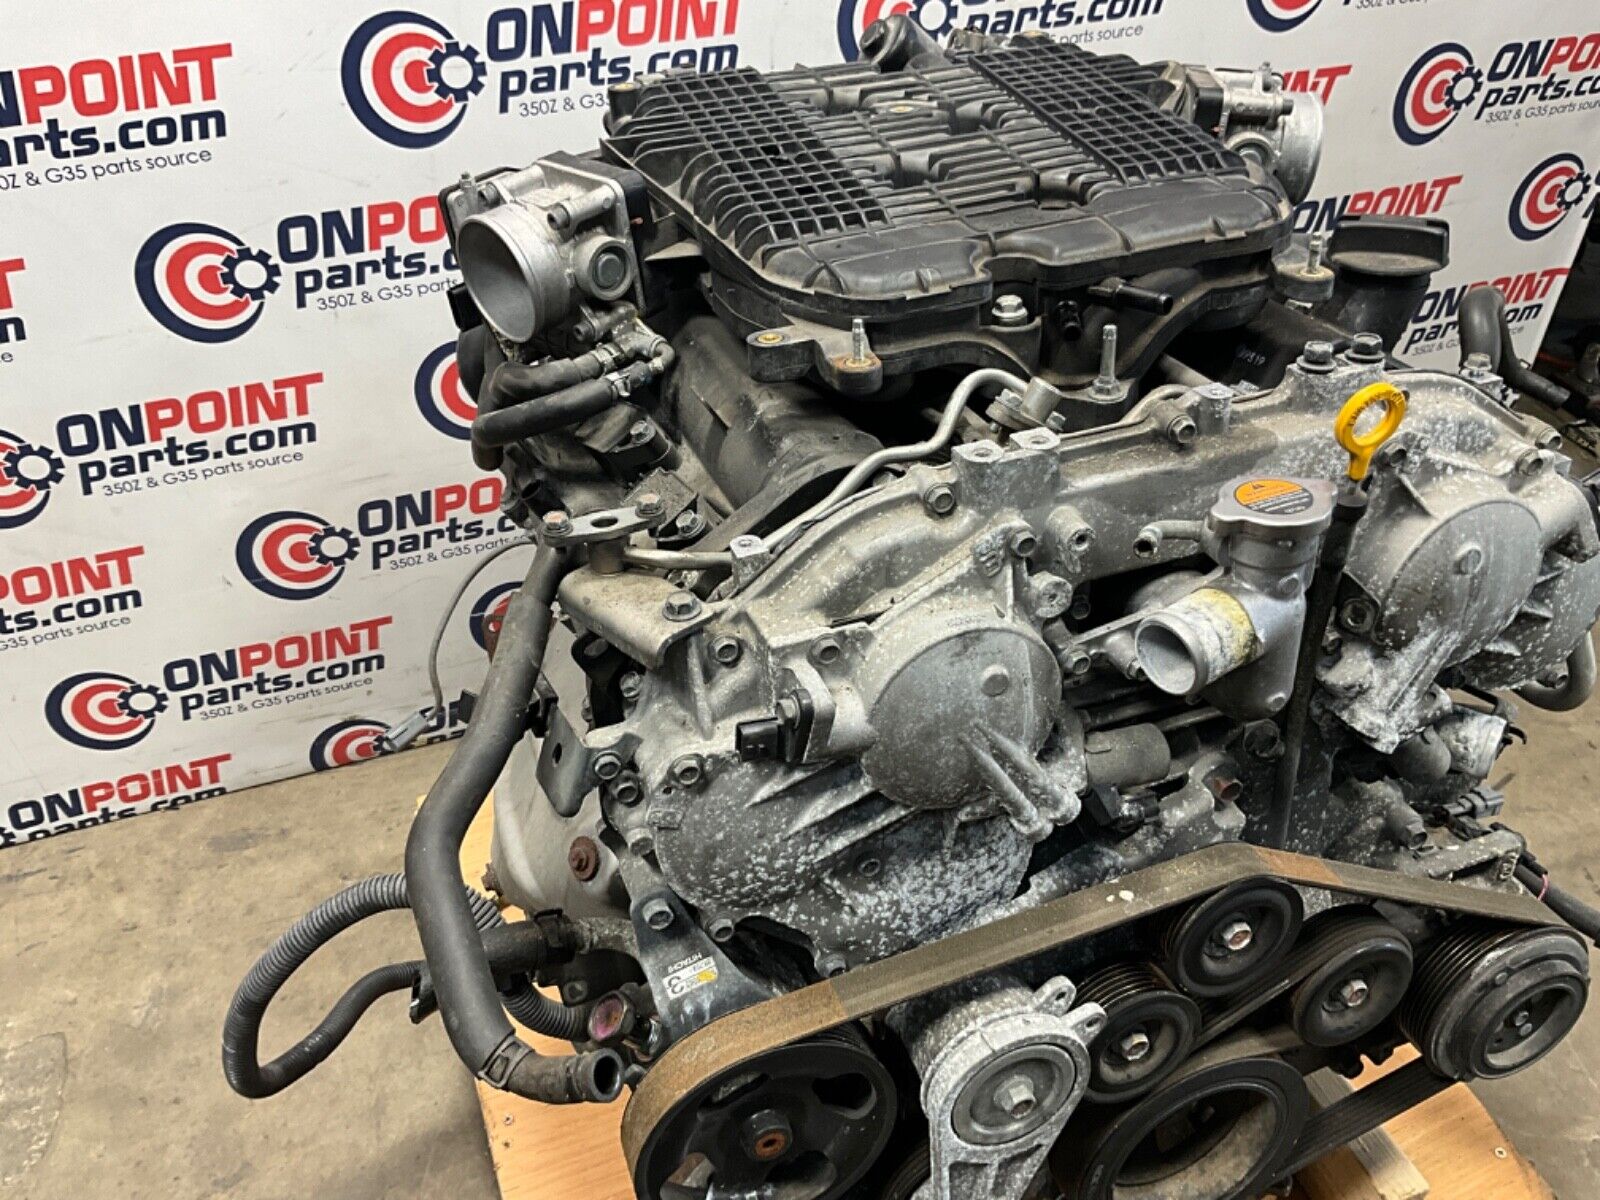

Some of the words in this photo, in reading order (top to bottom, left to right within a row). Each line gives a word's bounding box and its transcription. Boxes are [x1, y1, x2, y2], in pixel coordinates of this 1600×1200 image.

[1096, 24, 1144, 42] source
[519, 101, 557, 117] 350Z
[563, 97, 575, 112] &
[579, 94, 610, 108] G3
[1525, 104, 1547, 118] G35
[1549, 101, 1575, 117] parts
[25, 170, 41, 187] &
[45, 164, 87, 184] G35
[92, 159, 142, 181] parts
[146, 149, 212, 171] source
[1293, 174, 1463, 233] ONPOINT
[317, 293, 356, 310] 350Z
[361, 291, 373, 304] &
[378, 284, 413, 301] G35
[417, 278, 457, 297] parts
[56, 372, 324, 457] ONPOINT
[79, 422, 316, 496] parts.com
[103, 478, 141, 496] 350Z
[147, 476, 159, 488] &
[163, 469, 198, 485] G35
[202, 462, 244, 480] parts
[248, 451, 304, 470] source
[0, 546, 145, 605] OINT
[390, 555, 421, 571] 350Z
[427, 552, 438, 563] &
[441, 545, 471, 560] G35
[32, 627, 73, 645] parts
[77, 616, 131, 634] source
[163, 615, 393, 692] ONPOINT
[180, 654, 385, 721] parts.com
[200, 707, 233, 721] 350Z
[238, 705, 248, 714] &
[252, 695, 282, 710] G35
[285, 689, 321, 704] parts
[325, 677, 373, 694] source
[8, 753, 232, 830] ONPOINT
